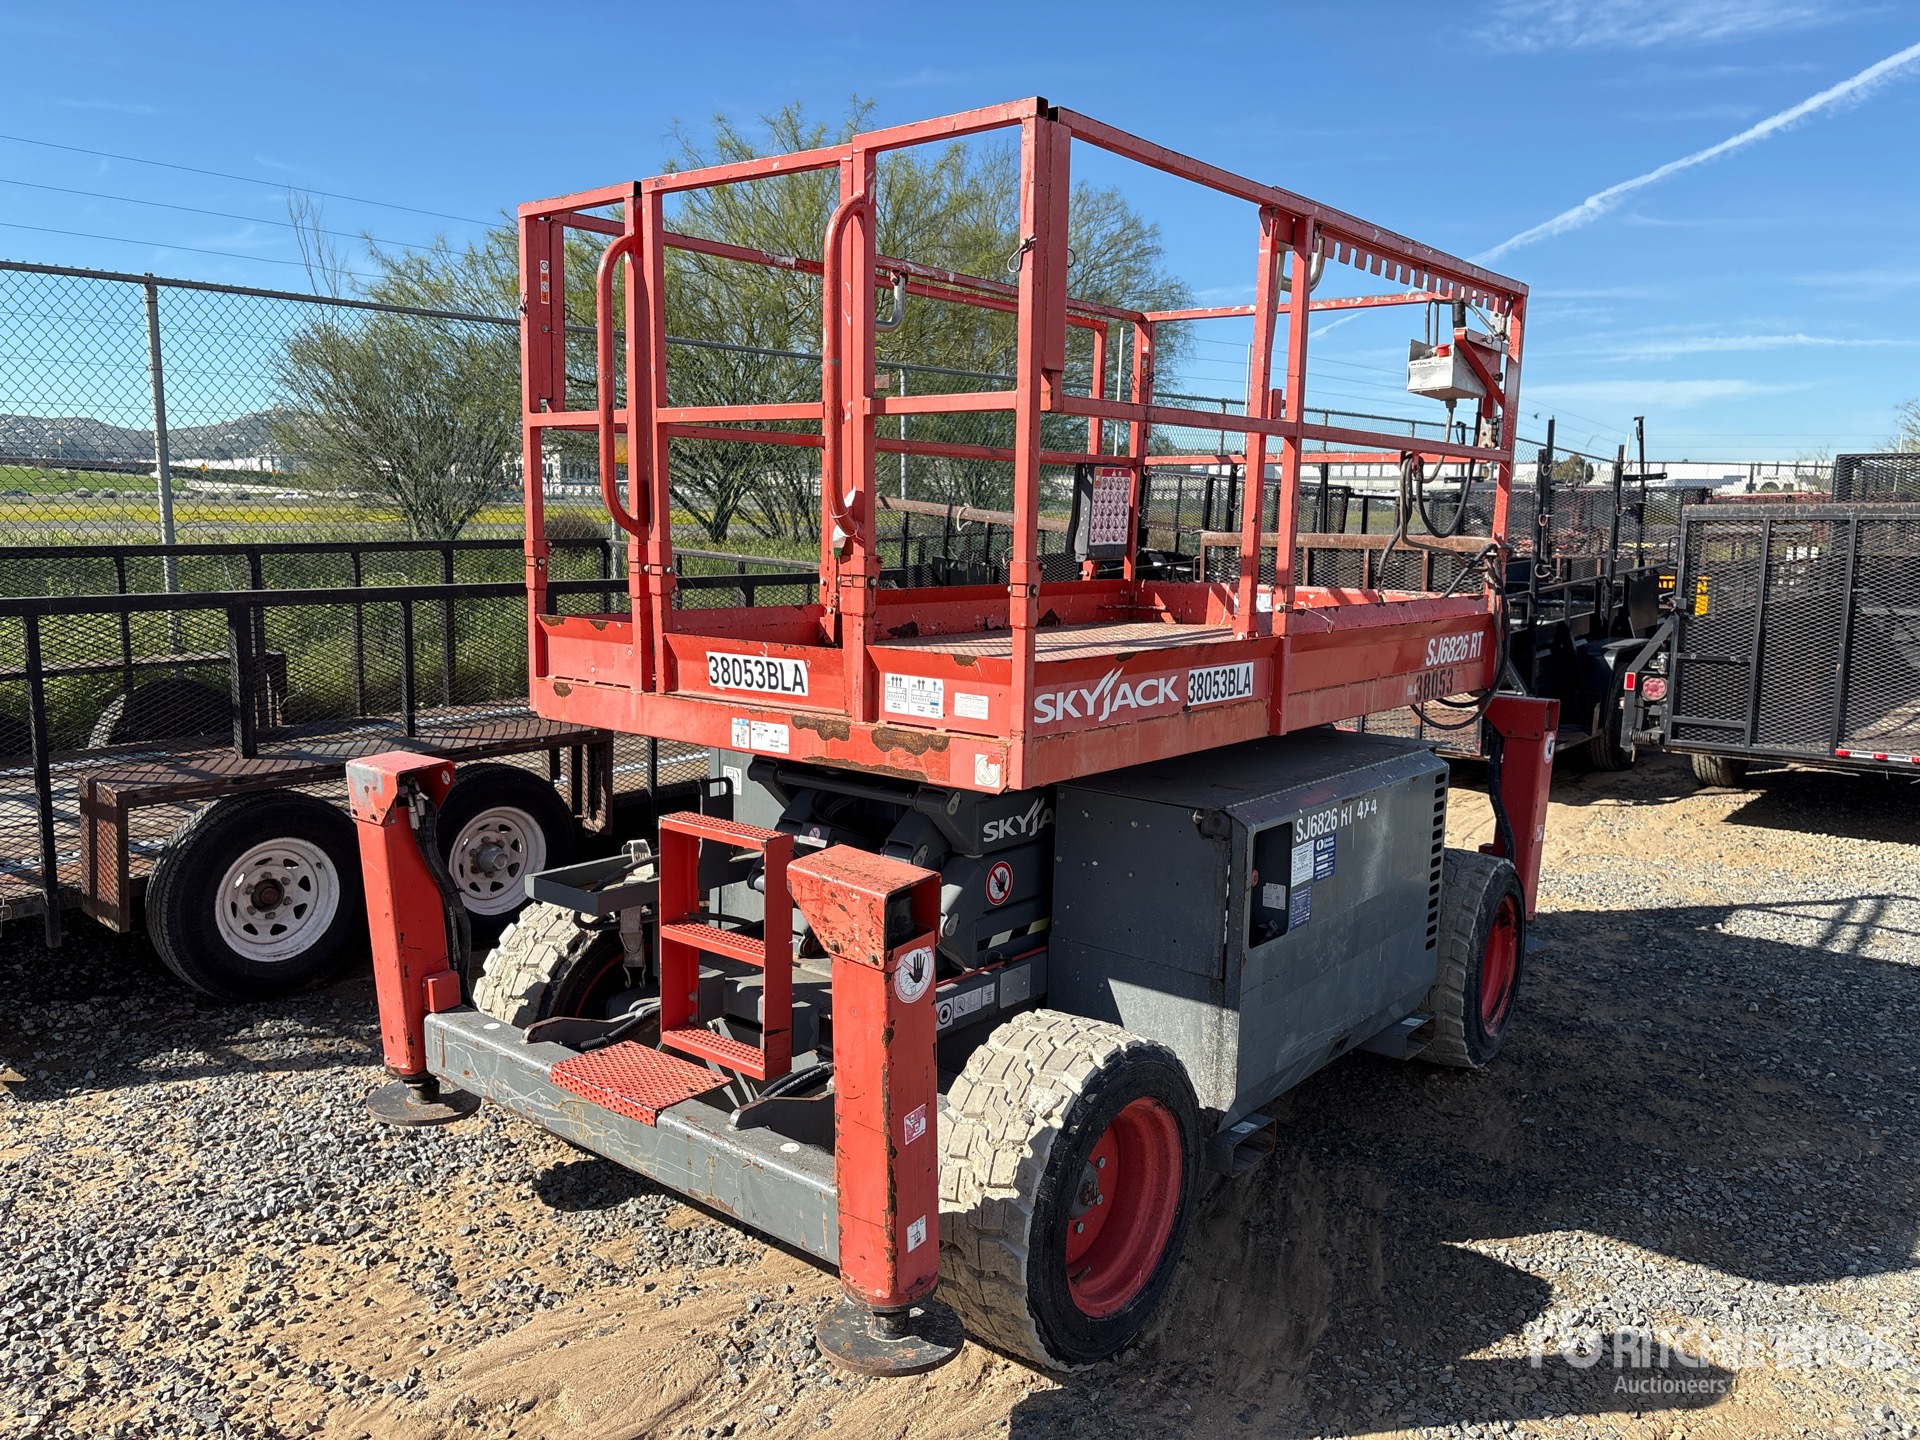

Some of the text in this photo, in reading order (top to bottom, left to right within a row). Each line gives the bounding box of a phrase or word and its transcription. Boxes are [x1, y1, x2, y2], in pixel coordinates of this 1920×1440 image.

[1426, 631, 1484, 666] SJ6826 RT
[708, 655, 806, 694] 38053BLA
[1188, 665, 1252, 704] 38053BLA
[1415, 668, 1454, 702] 38053
[1034, 667, 1179, 724] SKYJACK
[1295, 808, 1338, 843] SJ6826
